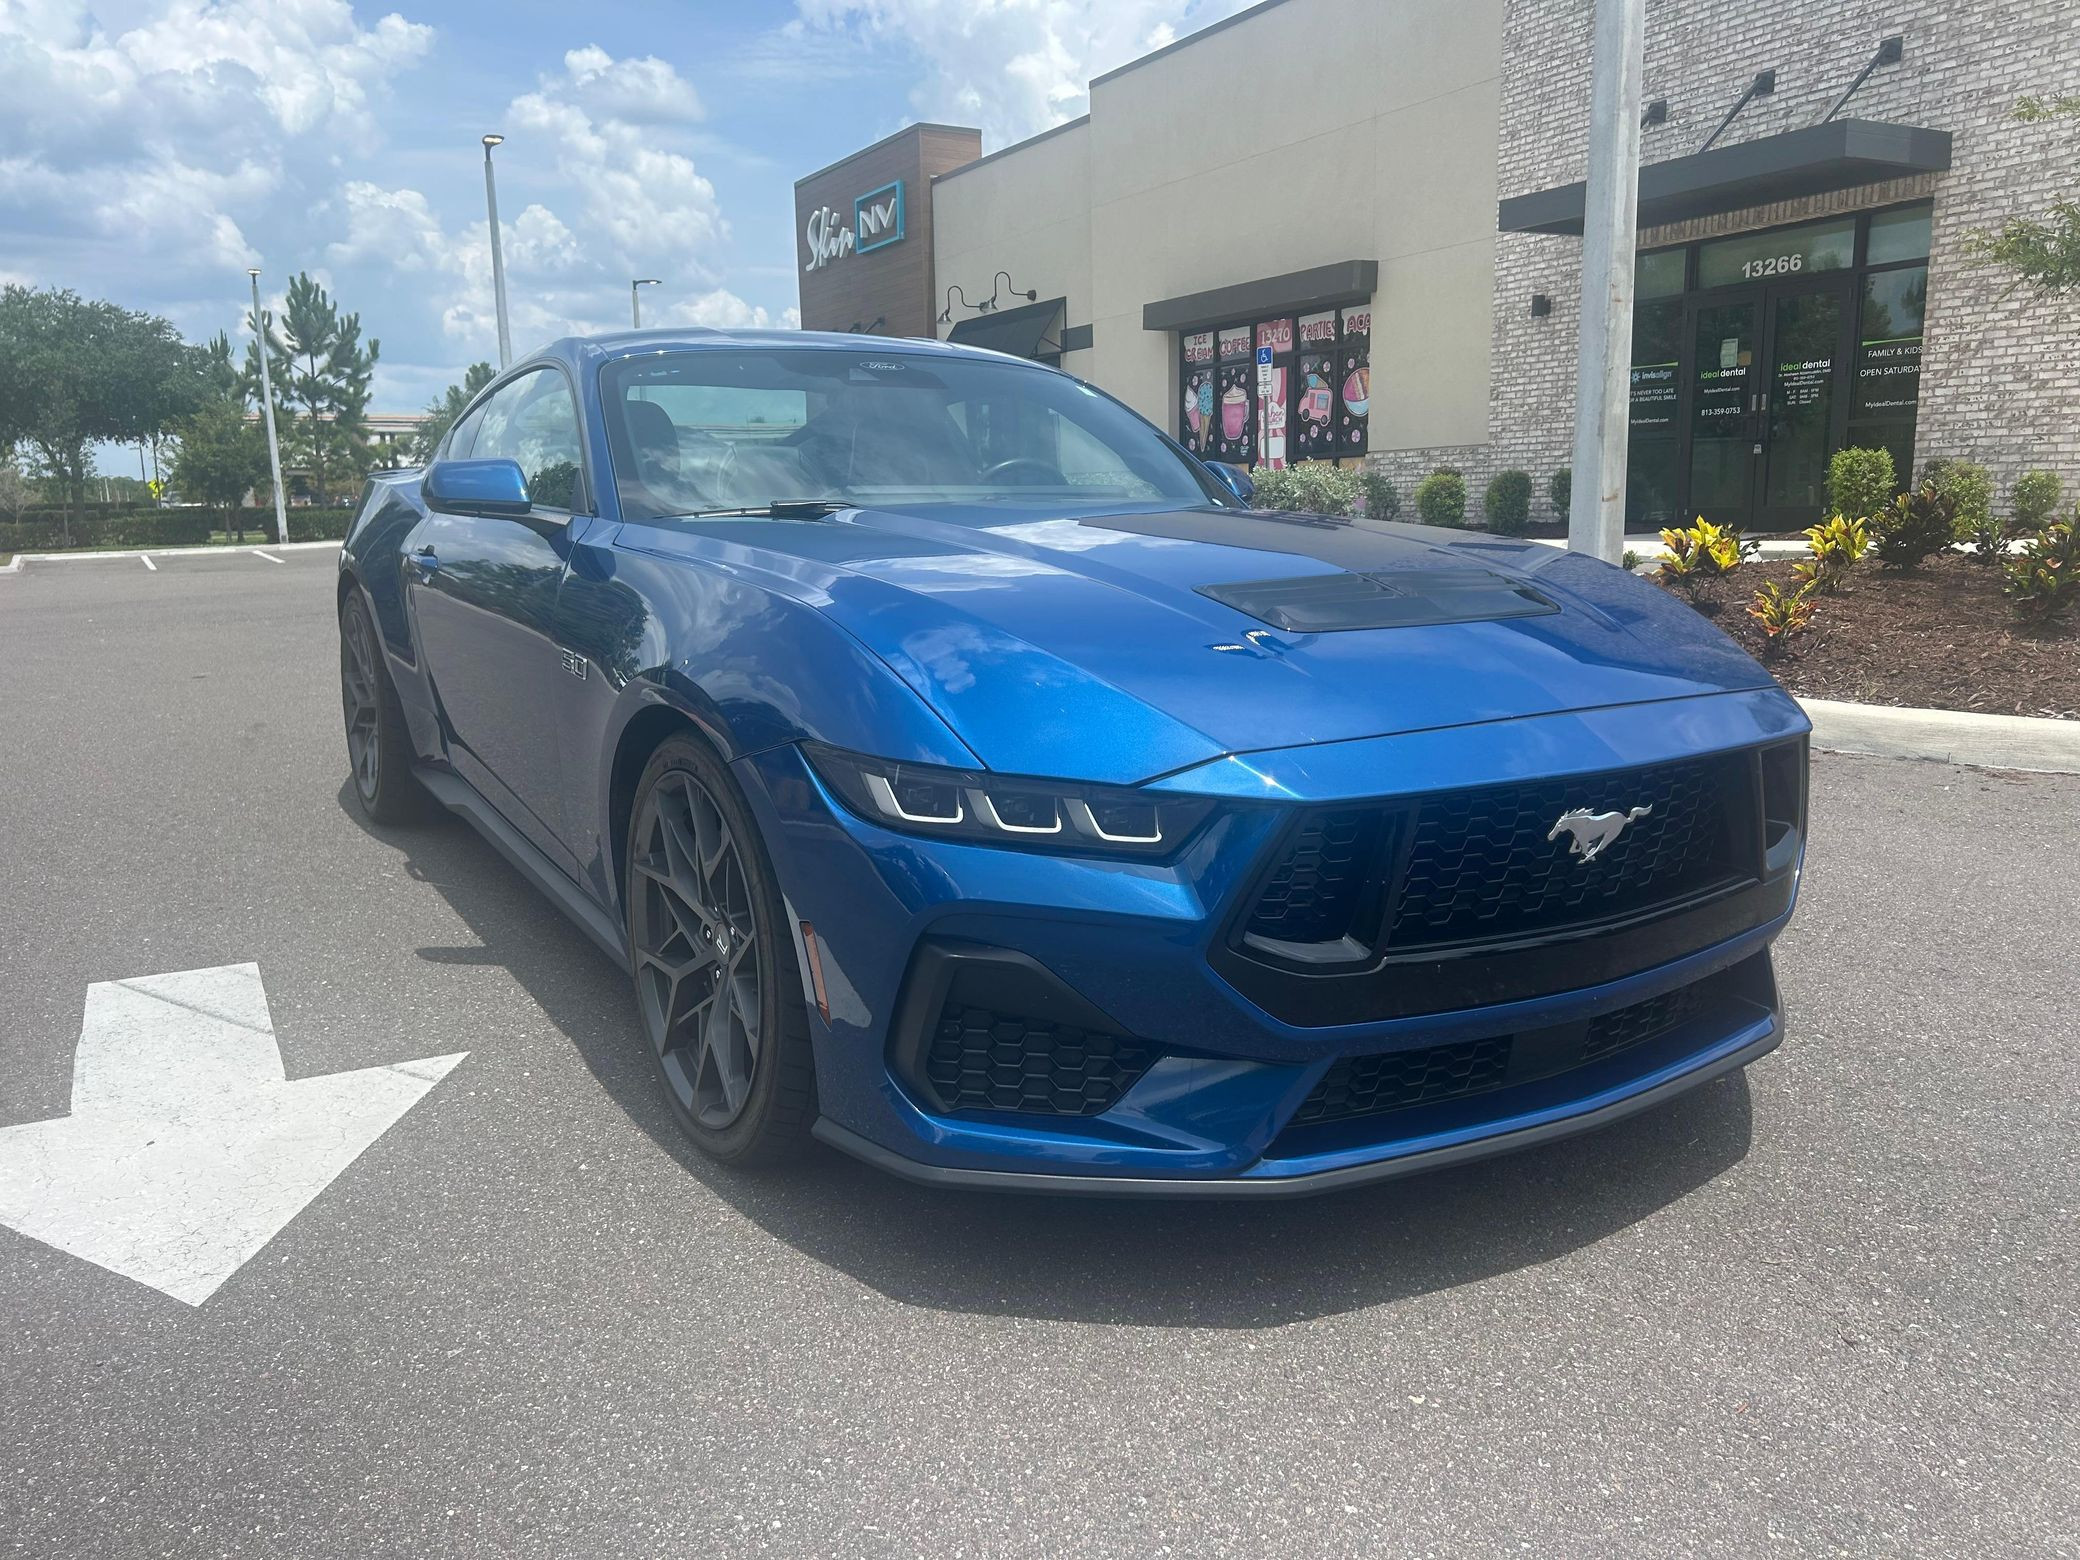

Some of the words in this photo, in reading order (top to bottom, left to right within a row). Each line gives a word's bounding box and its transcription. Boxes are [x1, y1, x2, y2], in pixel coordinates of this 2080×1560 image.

[805, 206, 855, 272] Skin
[859, 198, 897, 238] NV
[1741, 254, 1802, 278] 13266
[1347, 313, 1371, 333] ACA
[1193, 334, 1207, 346] ICE
[1261, 327, 1291, 345] 13270
[1220, 336, 1250, 356] COFFEE
[1867, 348, 1895, 358] FAMILY
[1896, 347, 1903, 356] &
[1185, 346, 1214, 362] CREAM
[1781, 362, 1801, 371] ideal
[1802, 358, 1831, 369] dental
[1700, 370, 1720, 379] ideal
[1720, 367, 1746, 377] dental
[1860, 368, 1882, 377] OPEN
[1701, 407, 1741, 416] 813-359-0753
